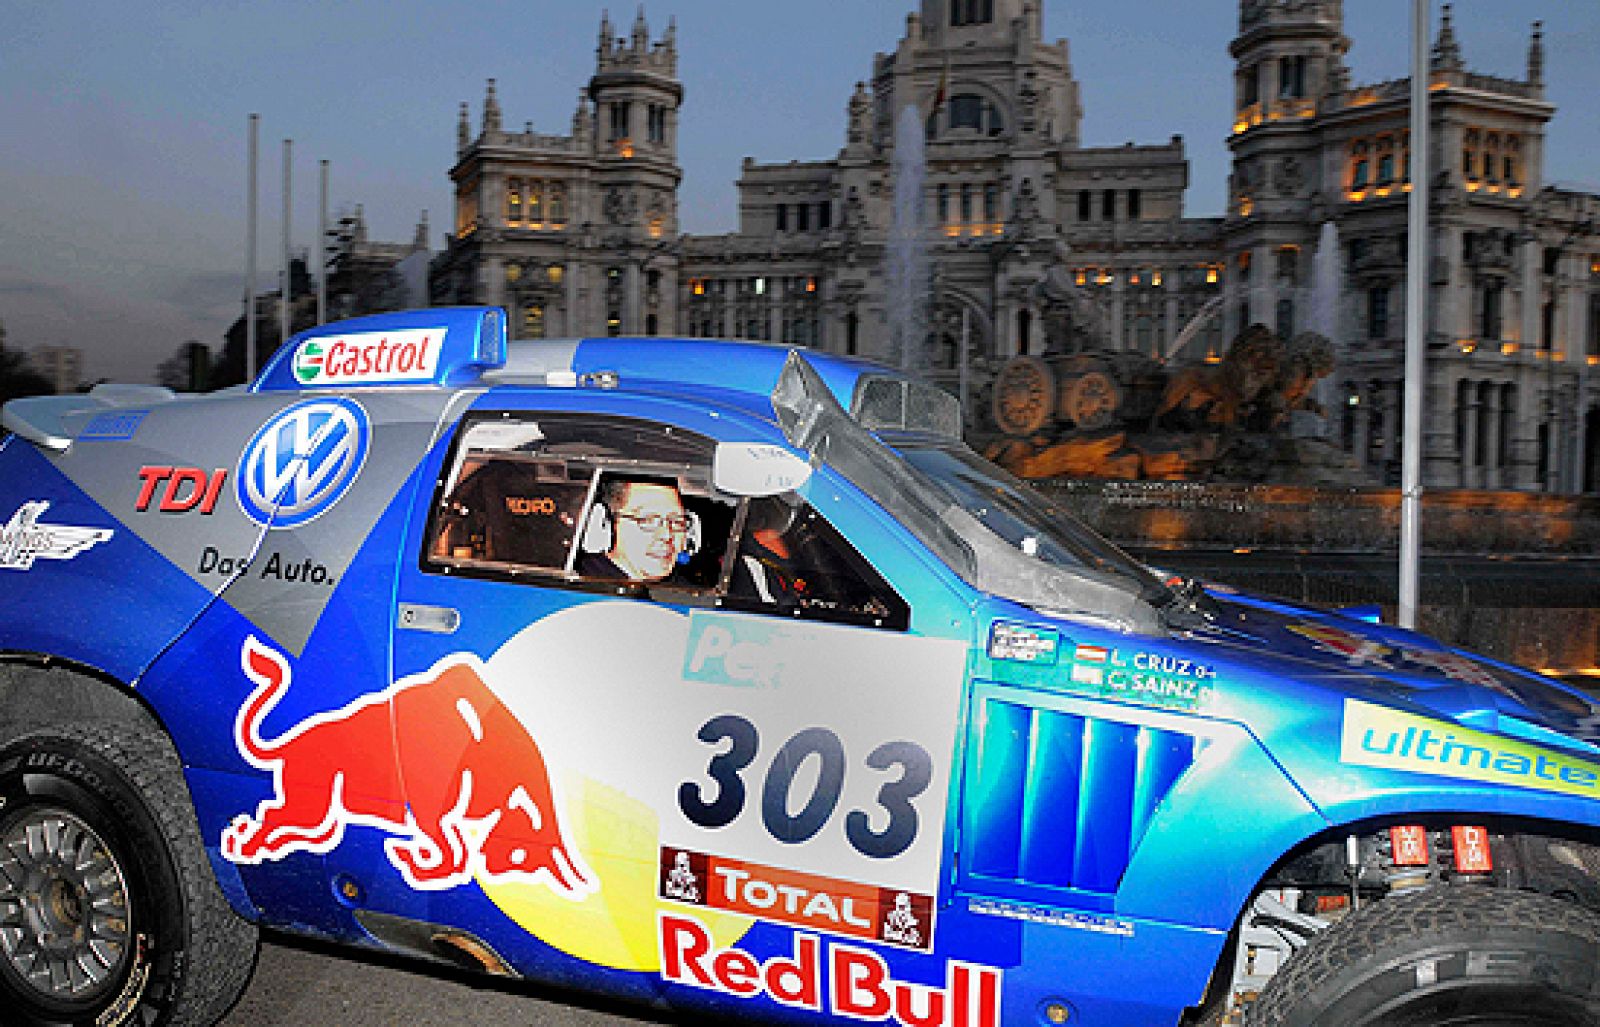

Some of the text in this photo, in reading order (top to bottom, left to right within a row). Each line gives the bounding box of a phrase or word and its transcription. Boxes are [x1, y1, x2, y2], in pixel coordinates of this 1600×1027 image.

[326, 336, 430, 378] Castrol
[135, 465, 228, 516] TDI
[198, 546, 335, 586] Das Auto.
[1131, 673, 1198, 700] SAINZ
[1134, 651, 1192, 677] CRUZ
[1361, 727, 1598, 788] ultimate
[677, 713, 933, 859] 303
[714, 866, 871, 929] TOTAL
[660, 914, 999, 1027] Red Bull
